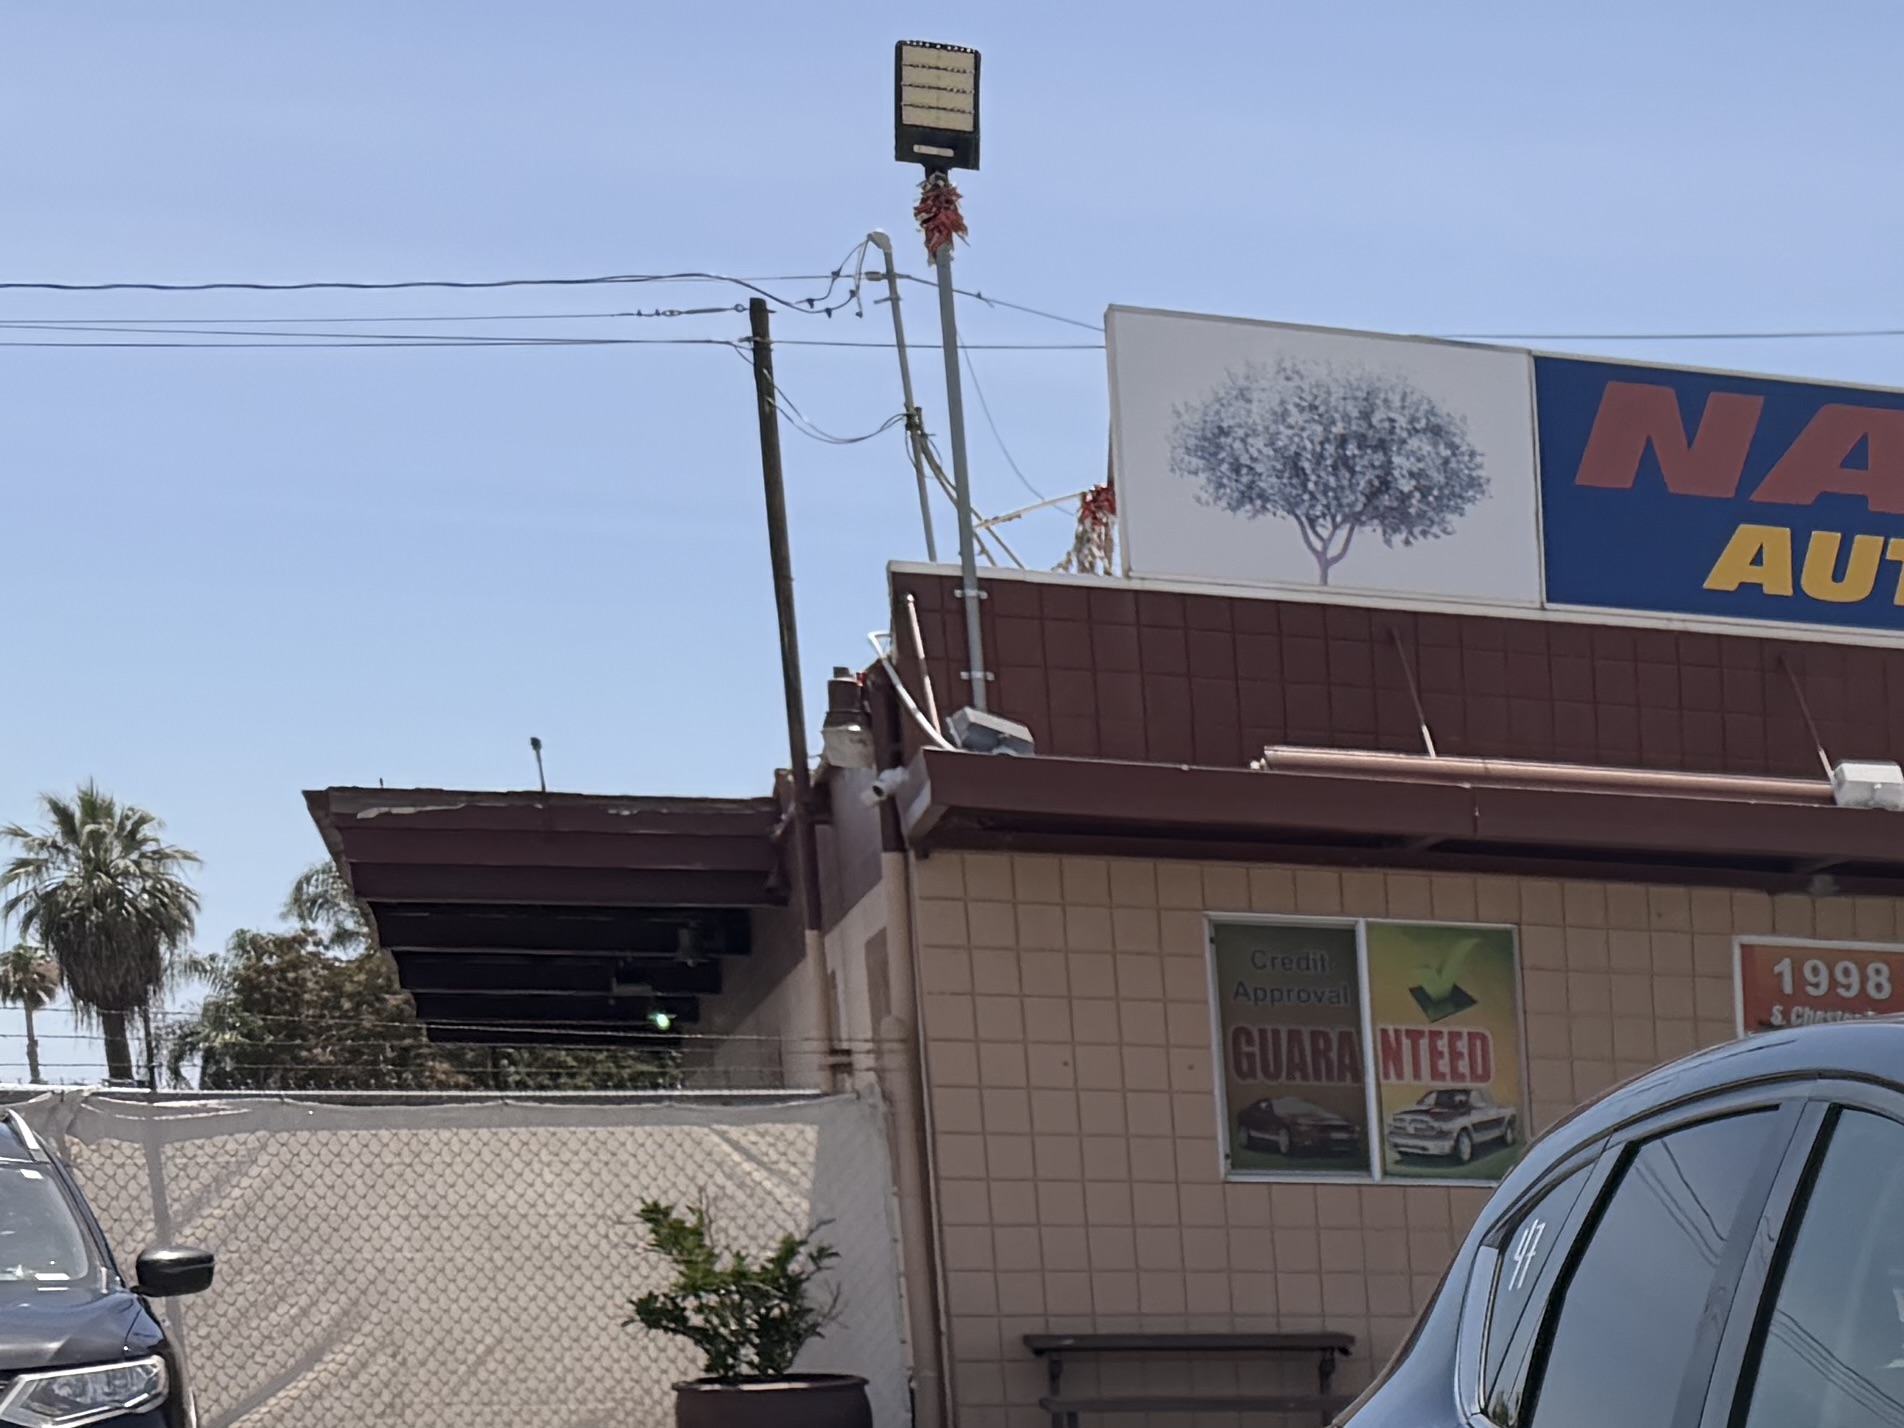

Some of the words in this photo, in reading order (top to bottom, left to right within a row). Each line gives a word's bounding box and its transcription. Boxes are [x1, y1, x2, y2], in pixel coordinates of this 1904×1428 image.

[1250, 949, 1329, 973] Credit
[1773, 957, 1892, 1000] 1998
[1232, 979, 1350, 1006] Approval
[1230, 1025, 1493, 1084] GUARANTEED
